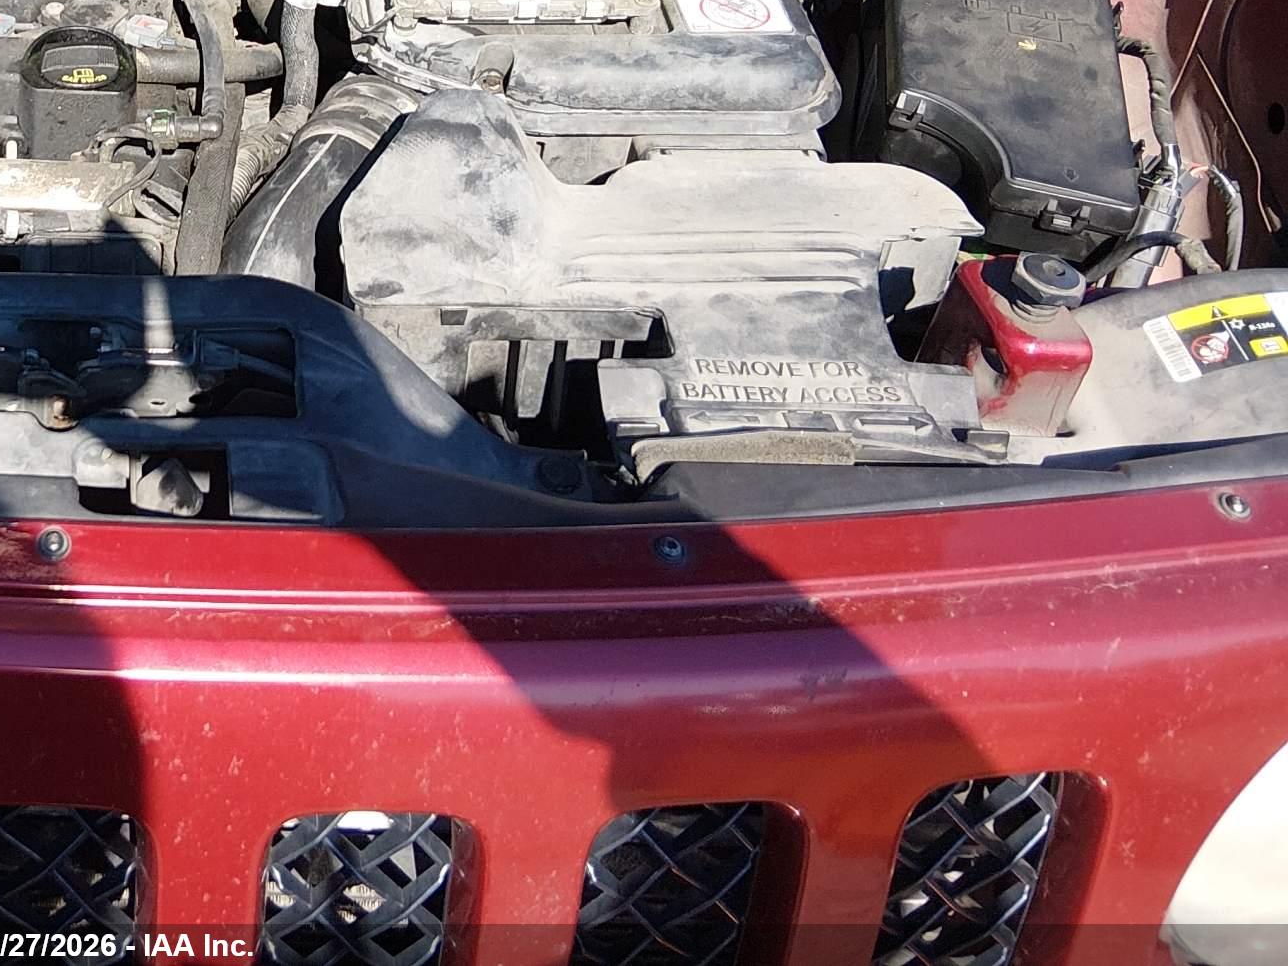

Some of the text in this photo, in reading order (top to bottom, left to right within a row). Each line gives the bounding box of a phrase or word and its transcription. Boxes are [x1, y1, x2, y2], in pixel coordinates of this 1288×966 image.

[694, 358, 863, 377] REMOVE FOR
[681, 382, 902, 403] BATTERY ACCESS
